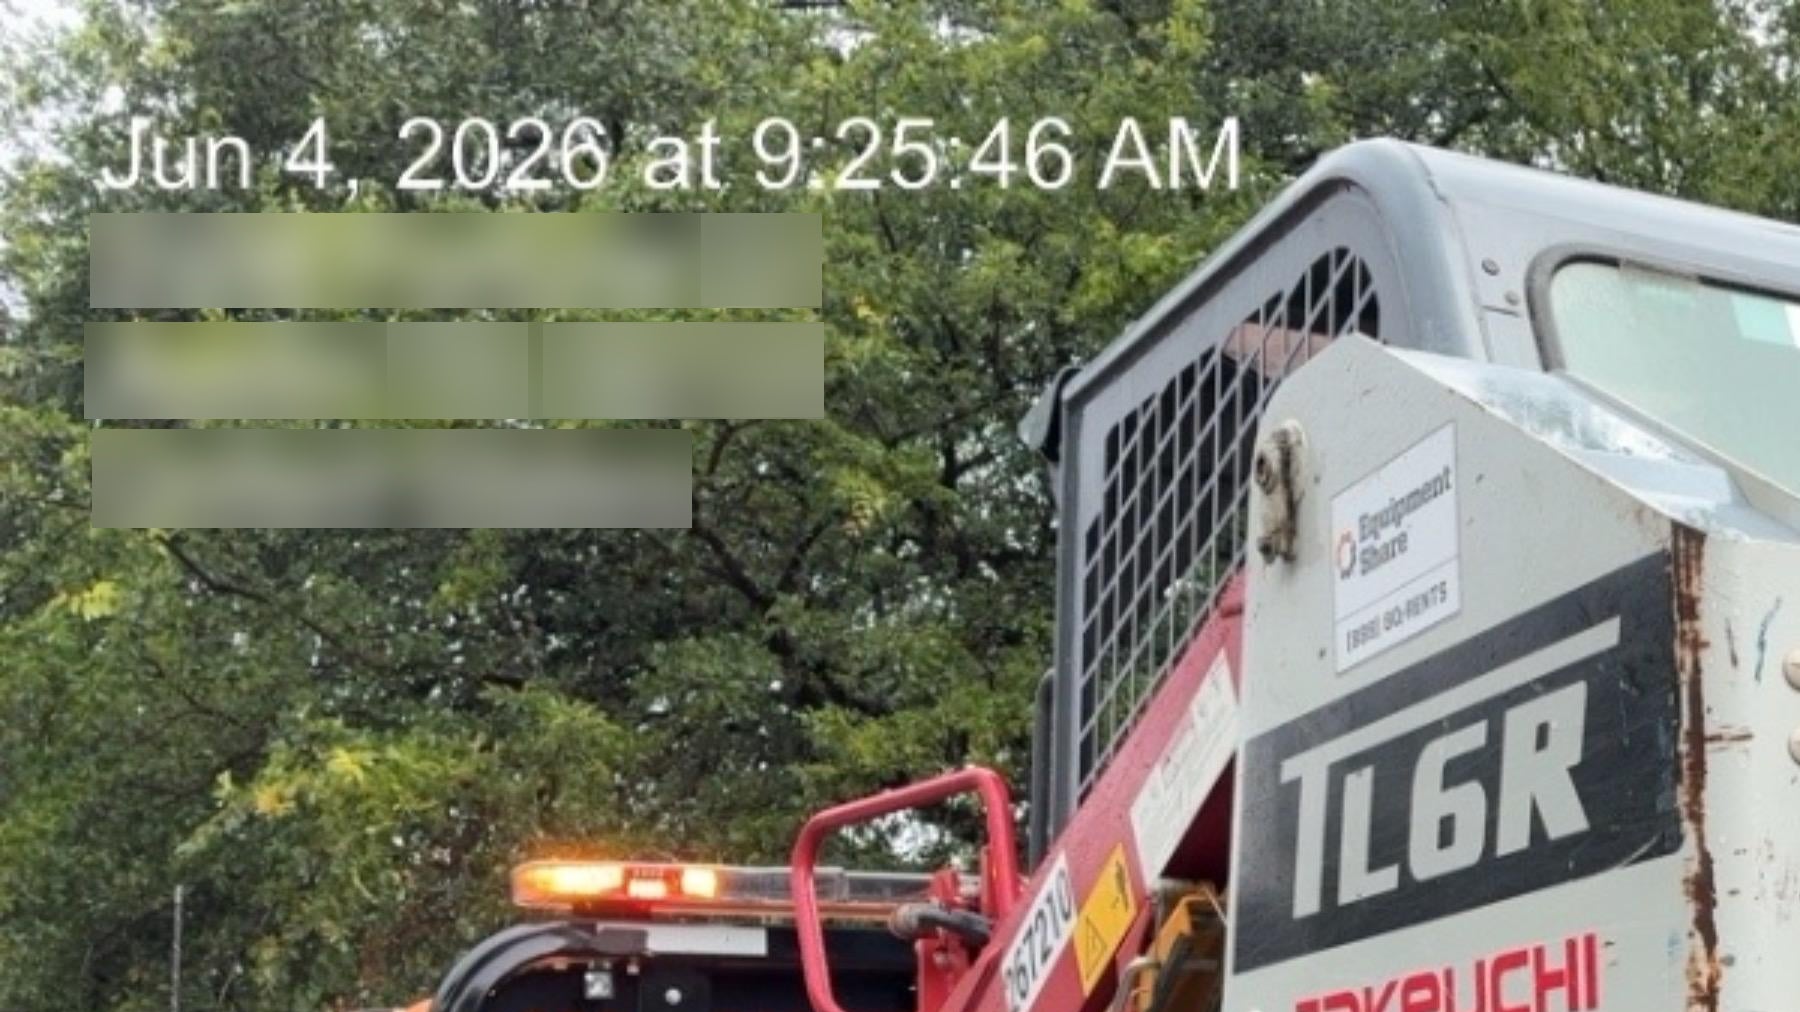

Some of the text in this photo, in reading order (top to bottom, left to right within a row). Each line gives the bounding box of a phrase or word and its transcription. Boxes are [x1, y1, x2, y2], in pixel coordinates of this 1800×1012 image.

[1358, 465, 1452, 543] Equipment
[1359, 531, 1409, 576] Share
[1280, 616, 1621, 920] TL6R
